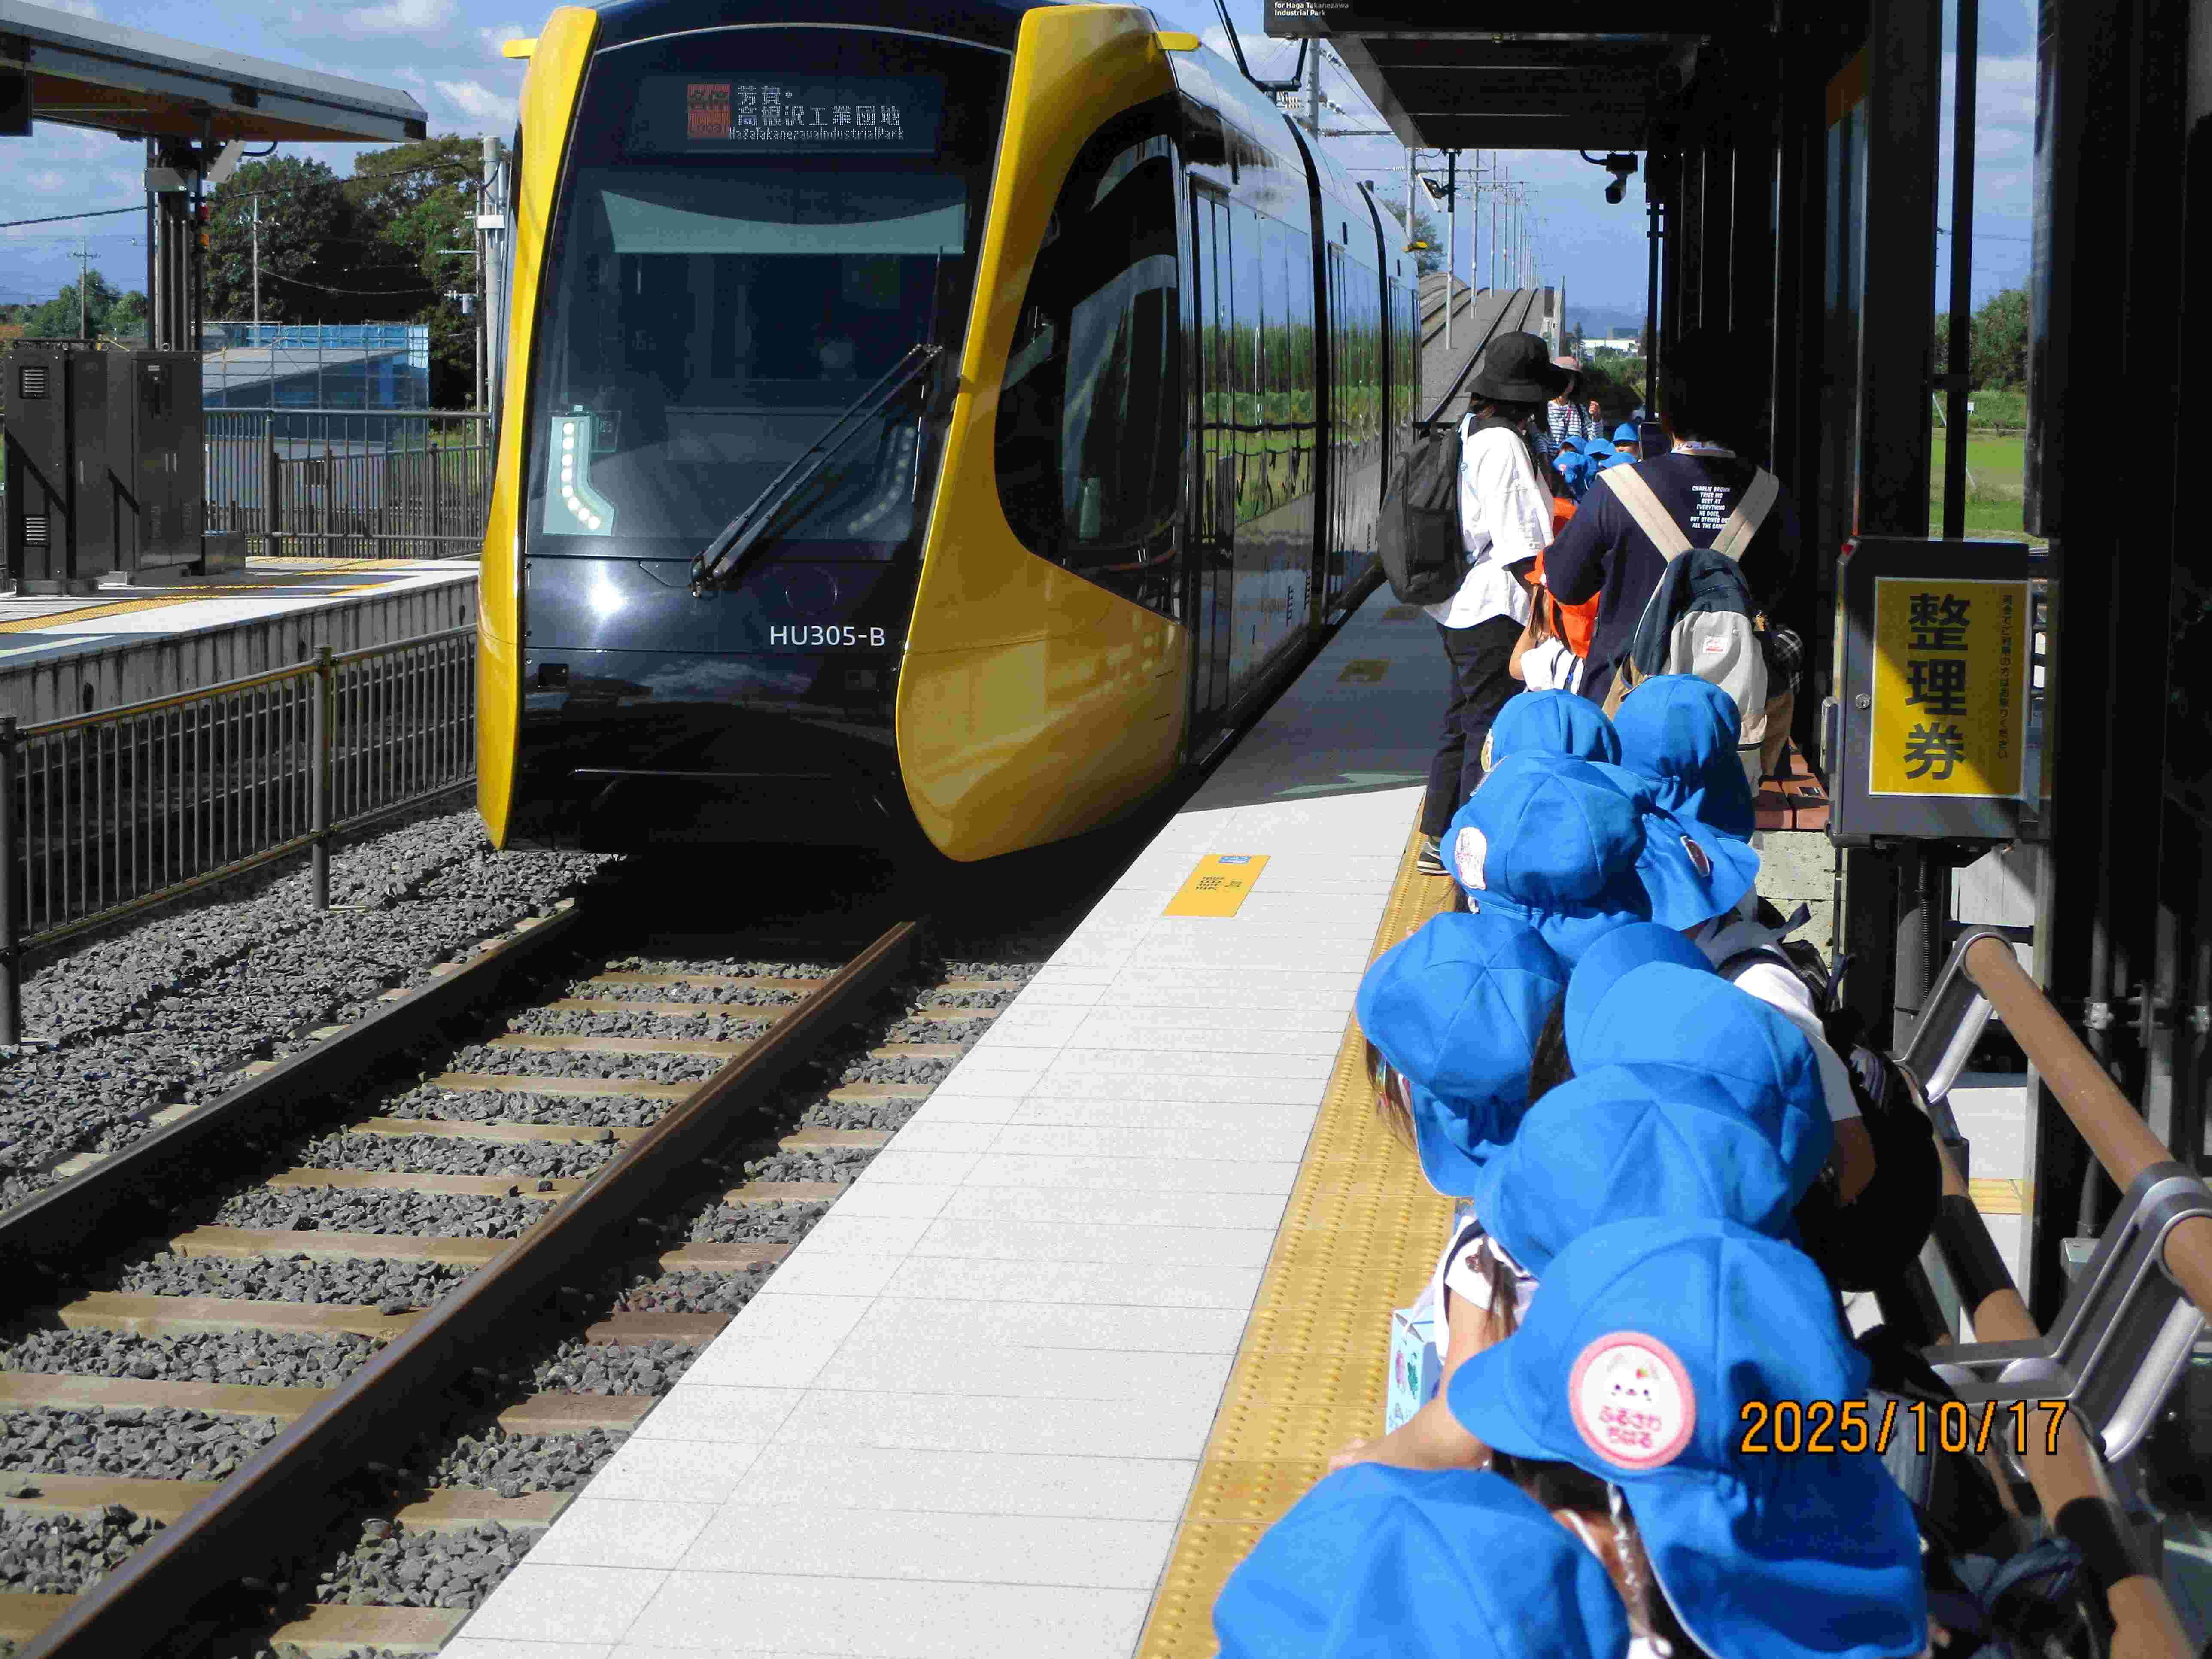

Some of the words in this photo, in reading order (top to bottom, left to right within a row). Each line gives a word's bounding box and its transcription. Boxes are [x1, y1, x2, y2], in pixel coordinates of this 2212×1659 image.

[738, 106, 901, 126] 高根沢工業団地
[770, 626, 886, 647] HU305-B
[1903, 593, 1971, 780] 整理券
